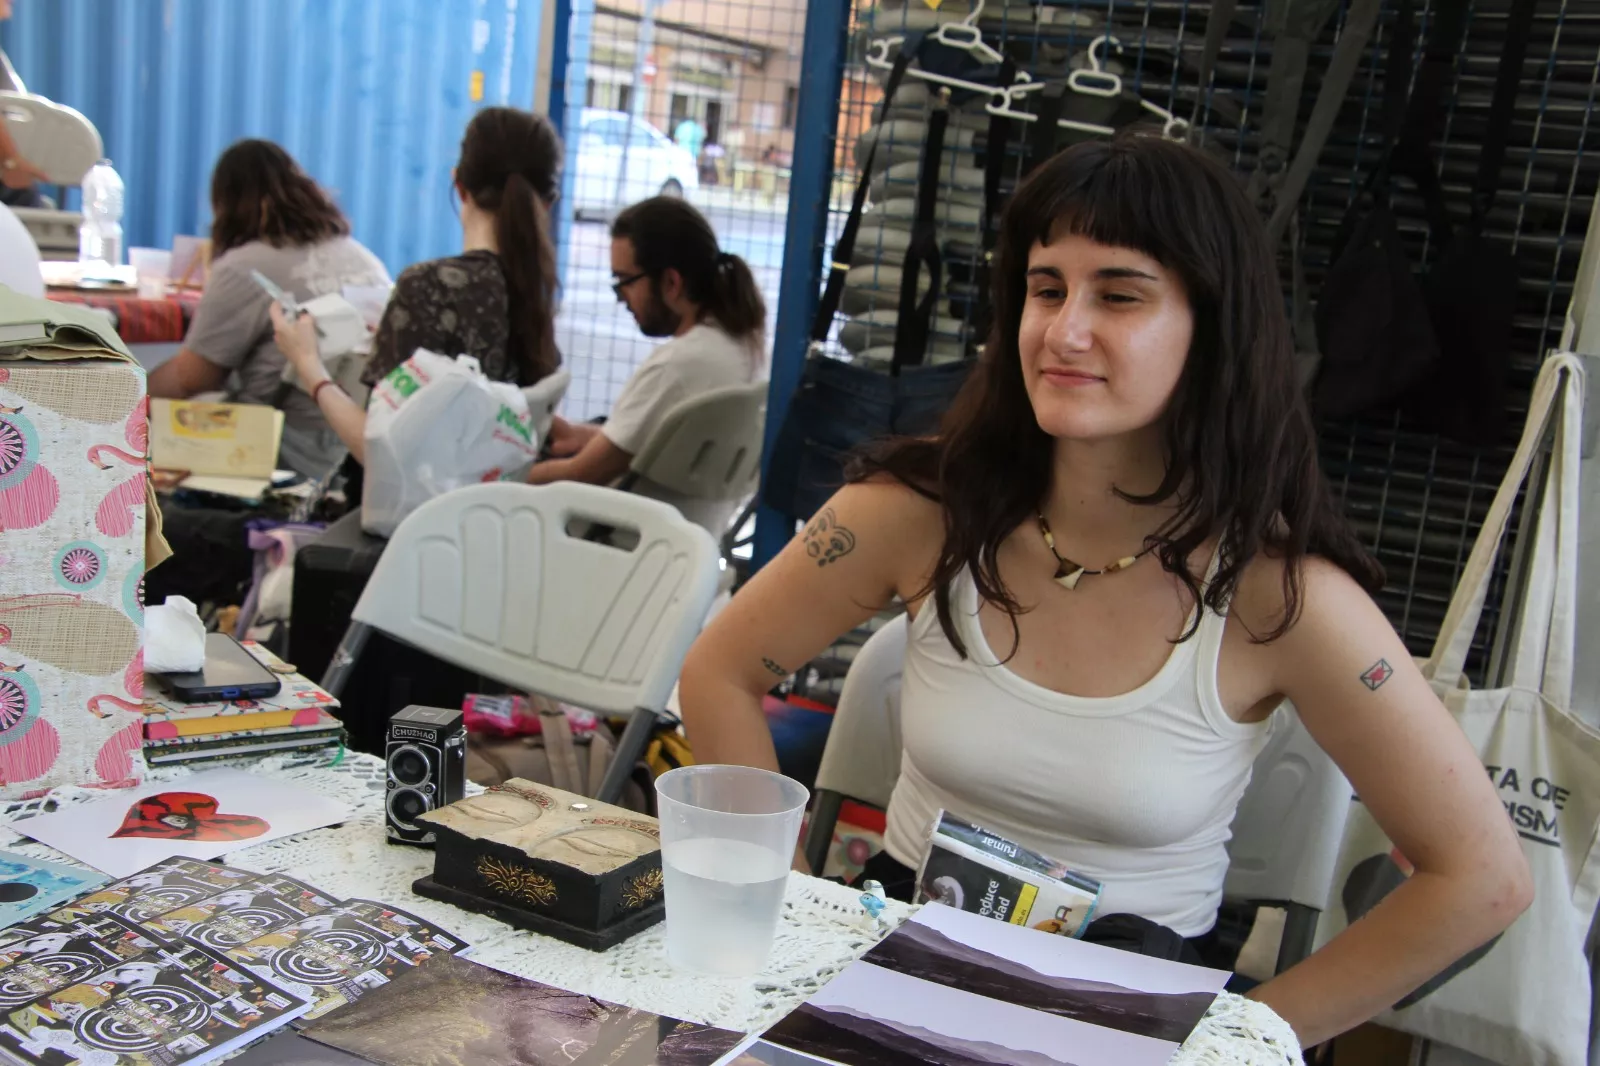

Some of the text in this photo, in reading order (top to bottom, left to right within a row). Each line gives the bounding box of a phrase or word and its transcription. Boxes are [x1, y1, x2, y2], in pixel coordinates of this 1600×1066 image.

[395, 728, 435, 740] CHUZHAO
[1484, 765, 1520, 792] TA
[982, 836, 1017, 858] Fumar
[980, 879, 1000, 916] educe
[993, 897, 1010, 922] dad
